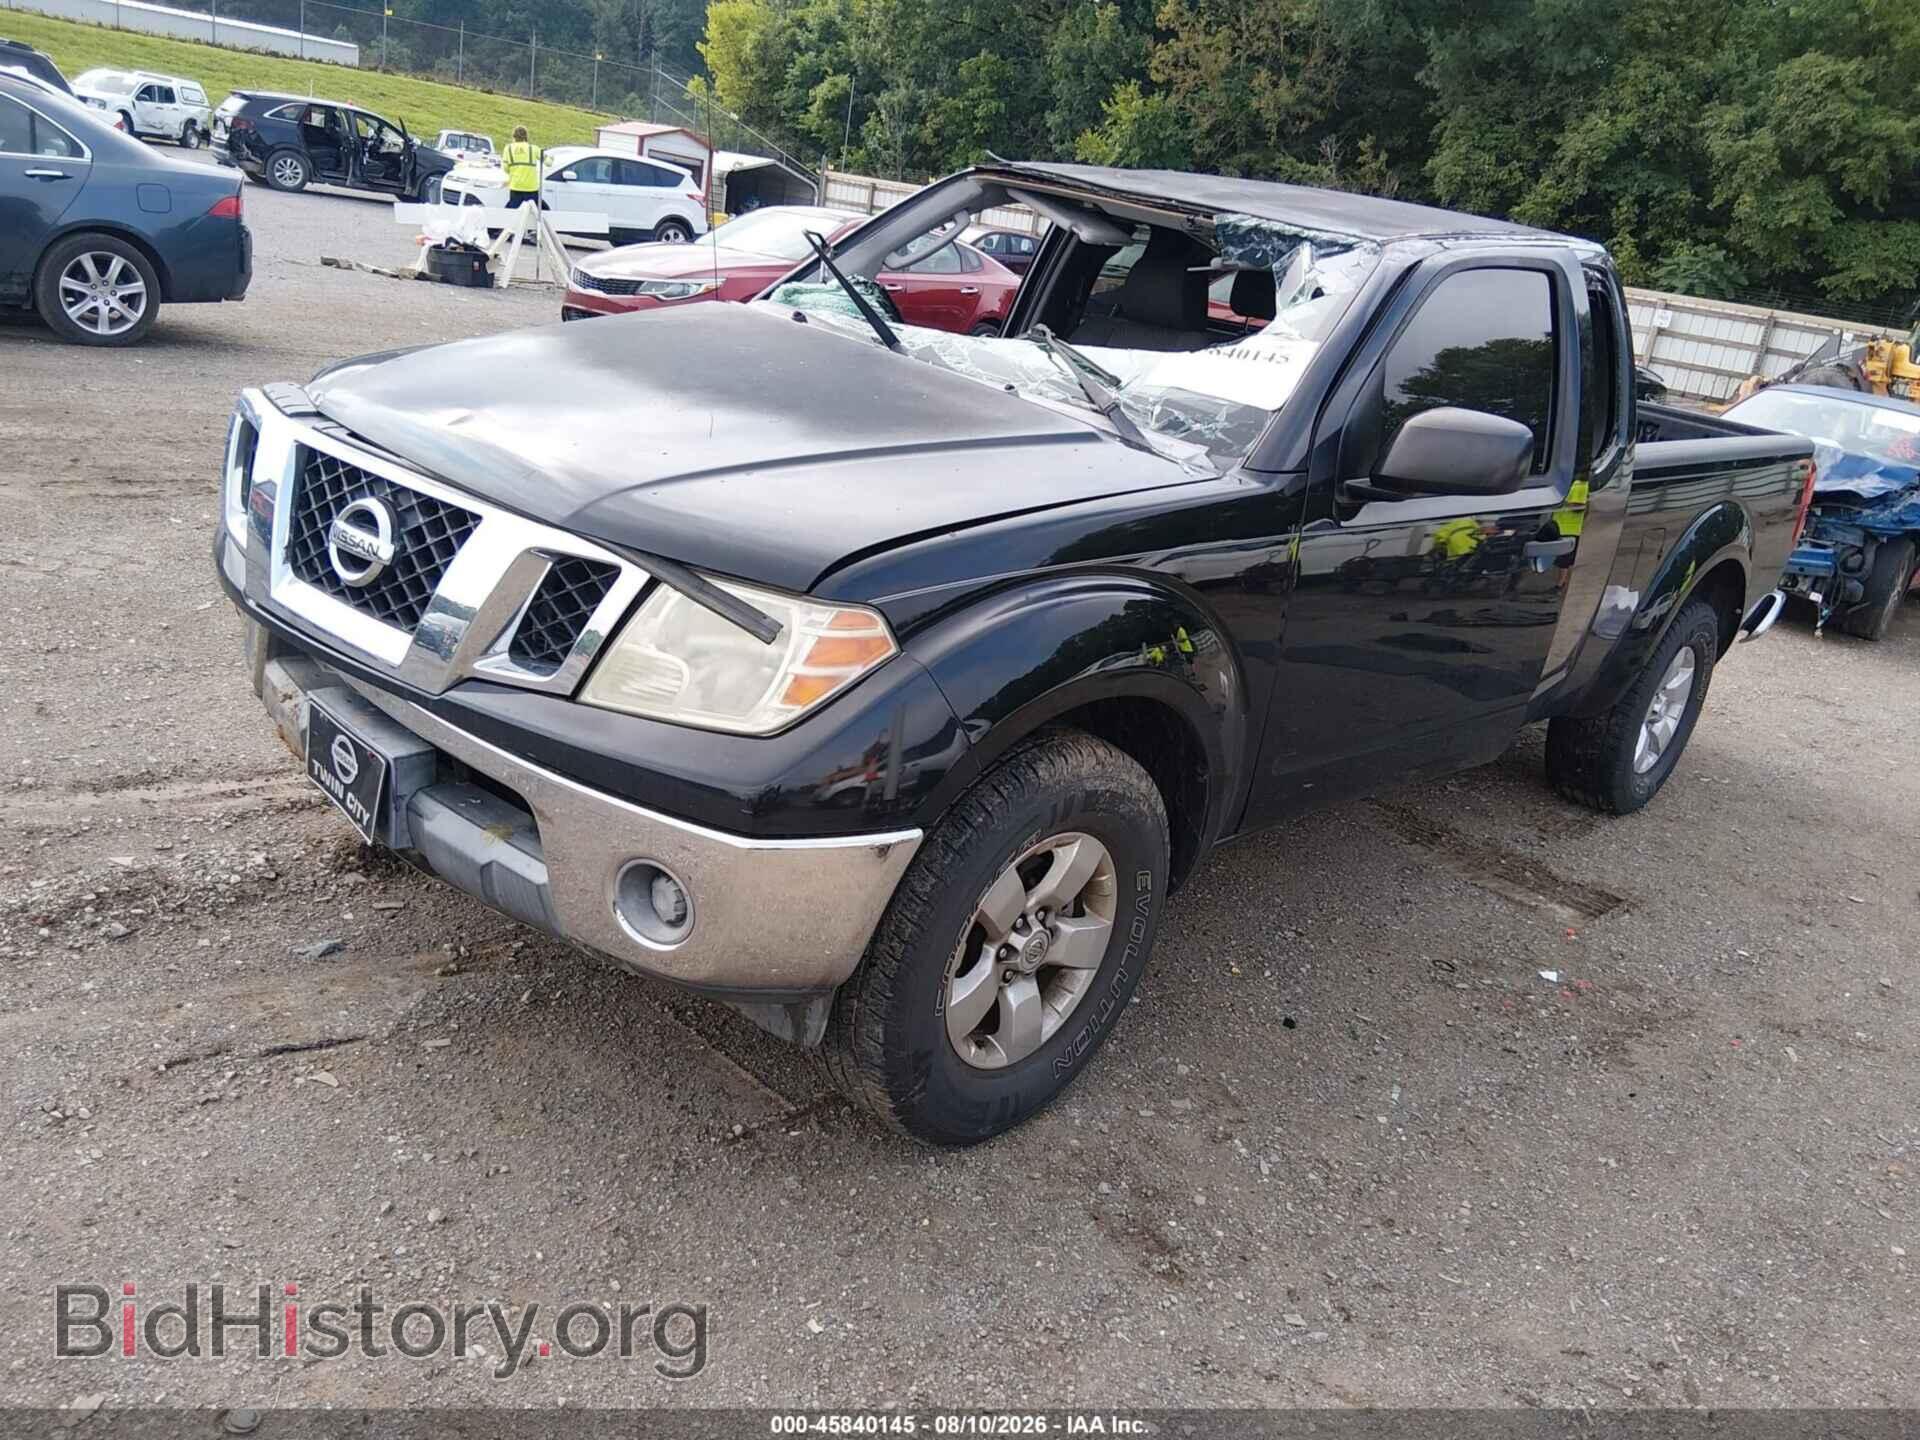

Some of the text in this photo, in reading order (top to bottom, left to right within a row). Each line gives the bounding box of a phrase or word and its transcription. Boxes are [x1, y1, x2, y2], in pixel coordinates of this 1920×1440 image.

[332, 526, 380, 557] NISSAN
[312, 759, 371, 827] TWIN CITY
[1052, 870, 1151, 1079] EVOLUTION
